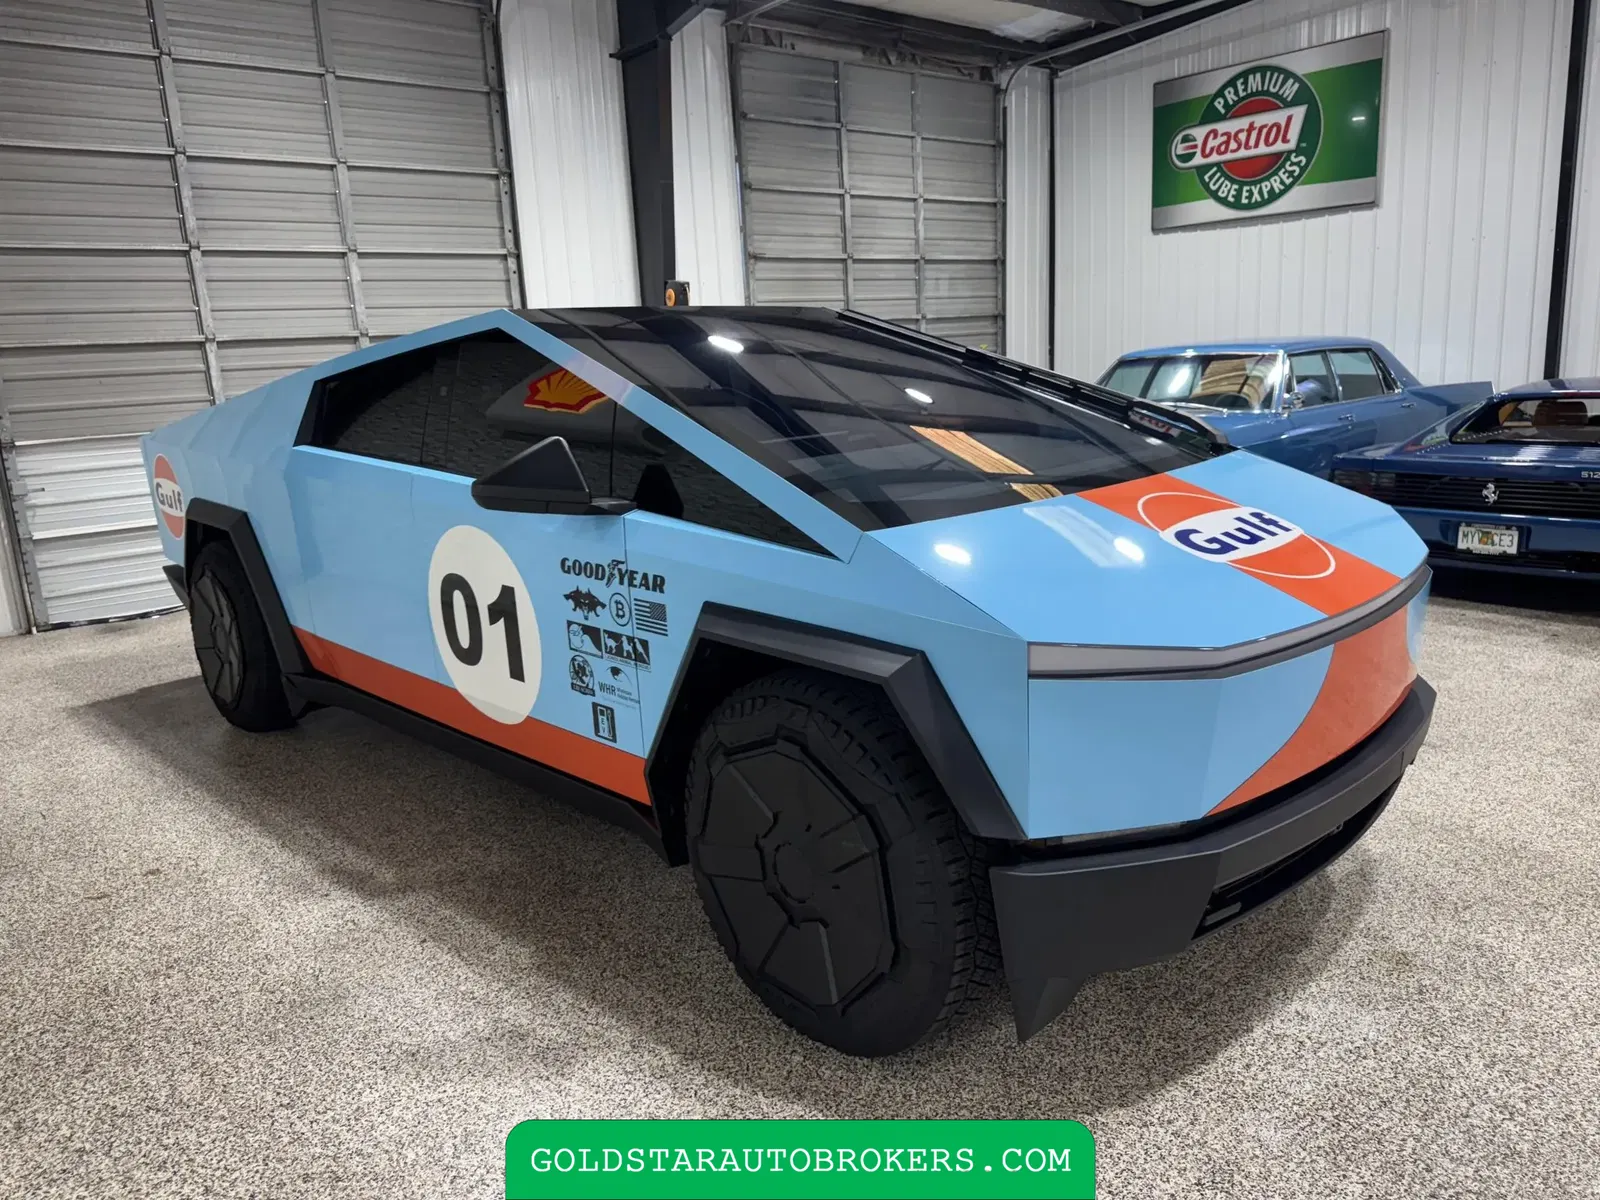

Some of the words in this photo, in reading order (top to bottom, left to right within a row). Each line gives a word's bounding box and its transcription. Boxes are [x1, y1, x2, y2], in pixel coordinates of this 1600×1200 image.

[1213, 70, 1300, 115] PREMIUM
[1200, 114, 1294, 160] Castrol
[1203, 166, 1237, 203] LUBE
[1241, 152, 1307, 204] EXPRESS
[1580, 470, 1600, 479] 512
[155, 482, 184, 513] Gulf
[1174, 511, 1293, 555] Gulf
[560, 557, 666, 594] GOODYEAR
[440, 572, 526, 683] 01
[598, 681, 617, 697] WHR
